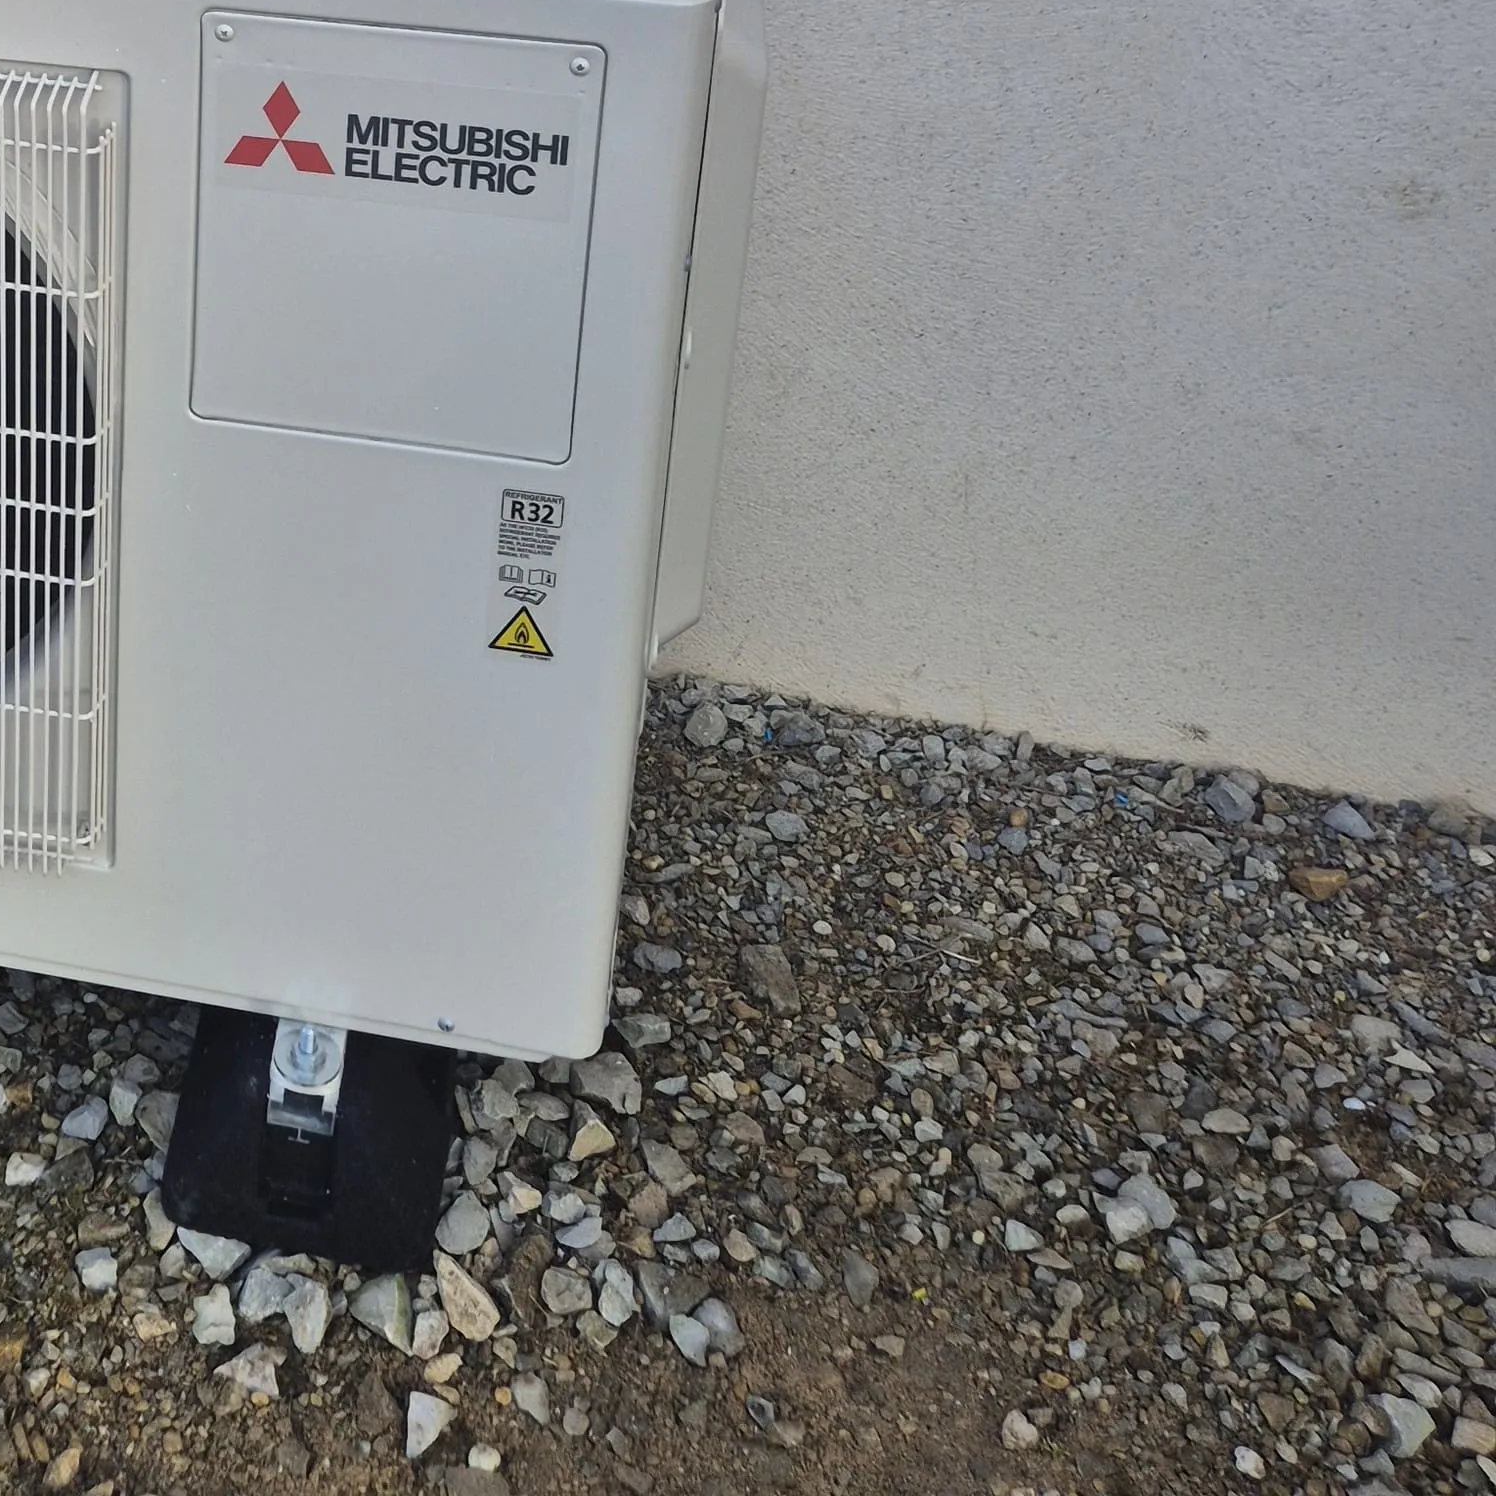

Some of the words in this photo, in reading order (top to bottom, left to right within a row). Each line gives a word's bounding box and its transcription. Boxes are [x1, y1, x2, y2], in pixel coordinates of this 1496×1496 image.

[346, 113, 570, 166] MITSUBISHI
[344, 147, 537, 196] ELECTRIC
[505, 491, 562, 505] REFRIGERANT
[510, 500, 555, 524] R32
